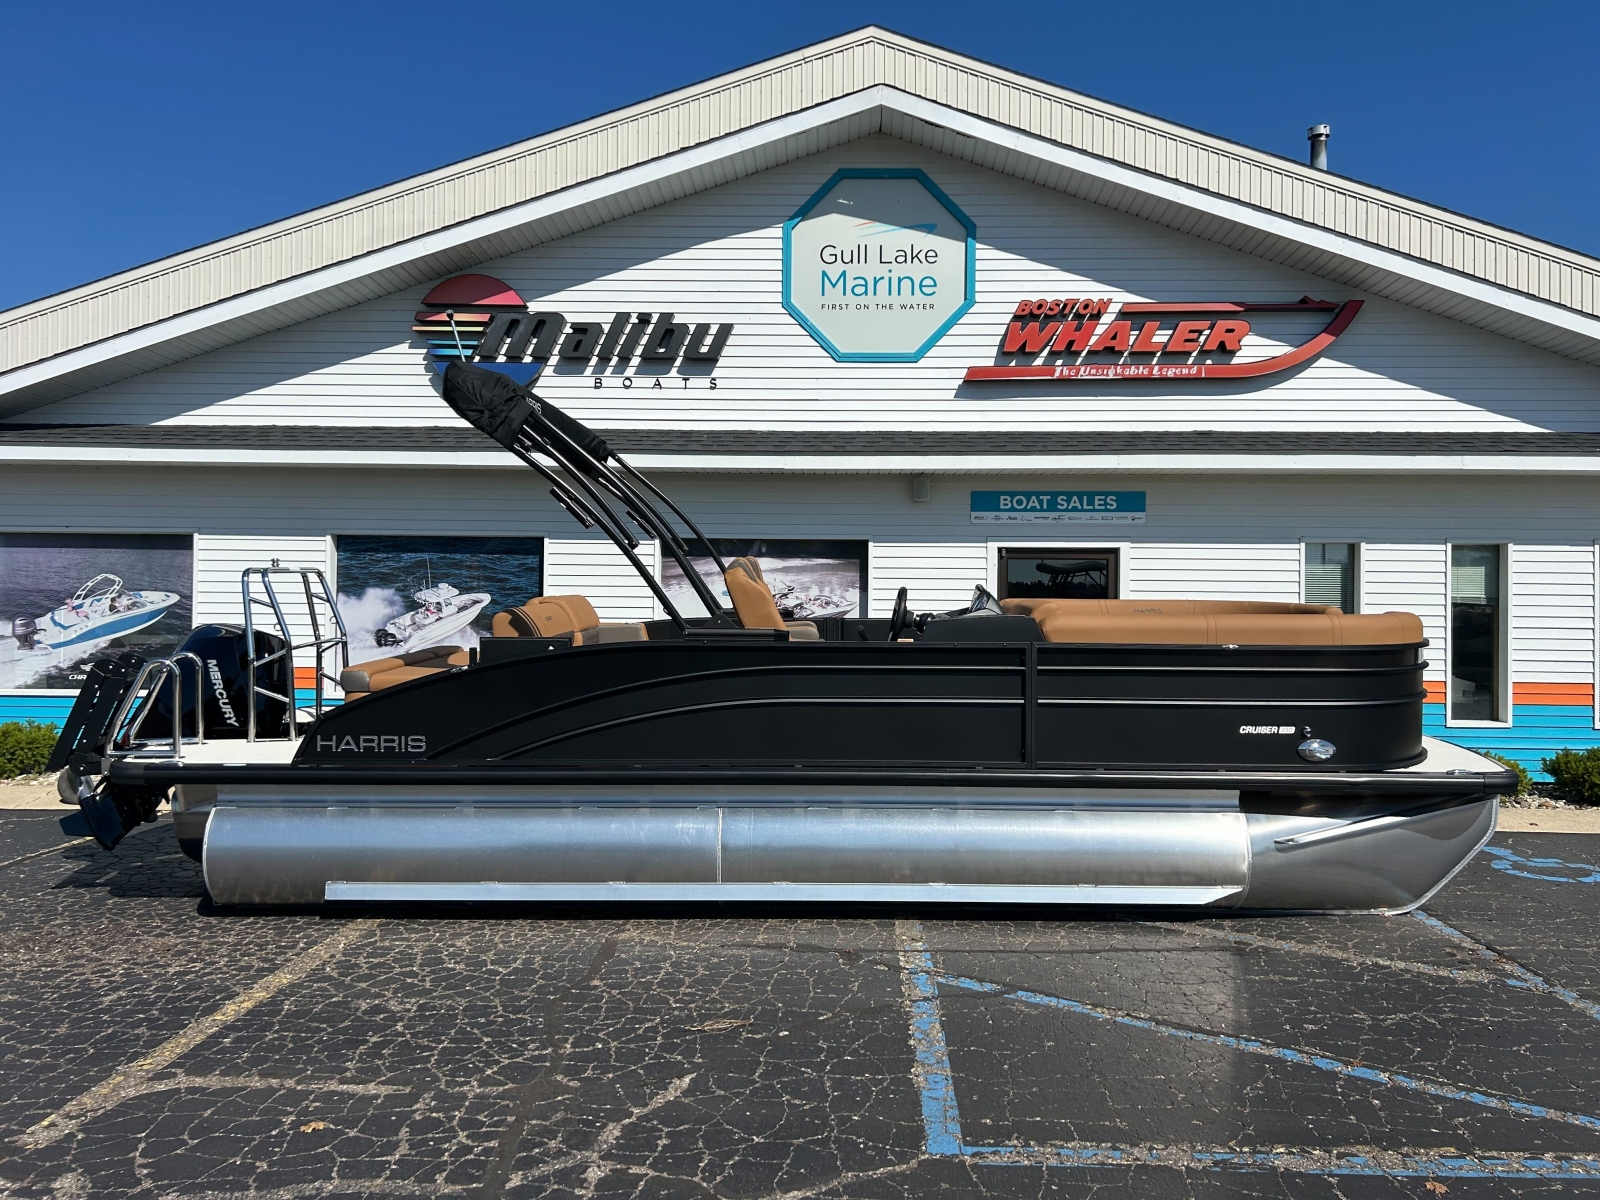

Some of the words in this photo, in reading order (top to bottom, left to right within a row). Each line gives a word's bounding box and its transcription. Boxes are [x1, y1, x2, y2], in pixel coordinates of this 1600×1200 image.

[819, 244, 868, 265] Gull
[879, 244, 938, 265] Lake
[821, 269, 938, 297] Marine
[821, 303, 850, 311] FIRST
[855, 303, 870, 311] ON
[875, 303, 894, 311] THE
[899, 303, 935, 311] WATER
[1014, 298, 1112, 316] BOSTON
[473, 311, 735, 361] Malibu
[1003, 320, 1250, 353] WHALER
[1054, 366, 1076, 378] The
[1152, 365, 1198, 377] Legend
[594, 377, 718, 390] BOATS
[999, 495, 1051, 510] BOAT
[1056, 495, 1117, 510] SALES
[206, 659, 240, 727] MERCURY
[1240, 725, 1279, 734] CRUISER
[316, 734, 427, 752] HARRIS
